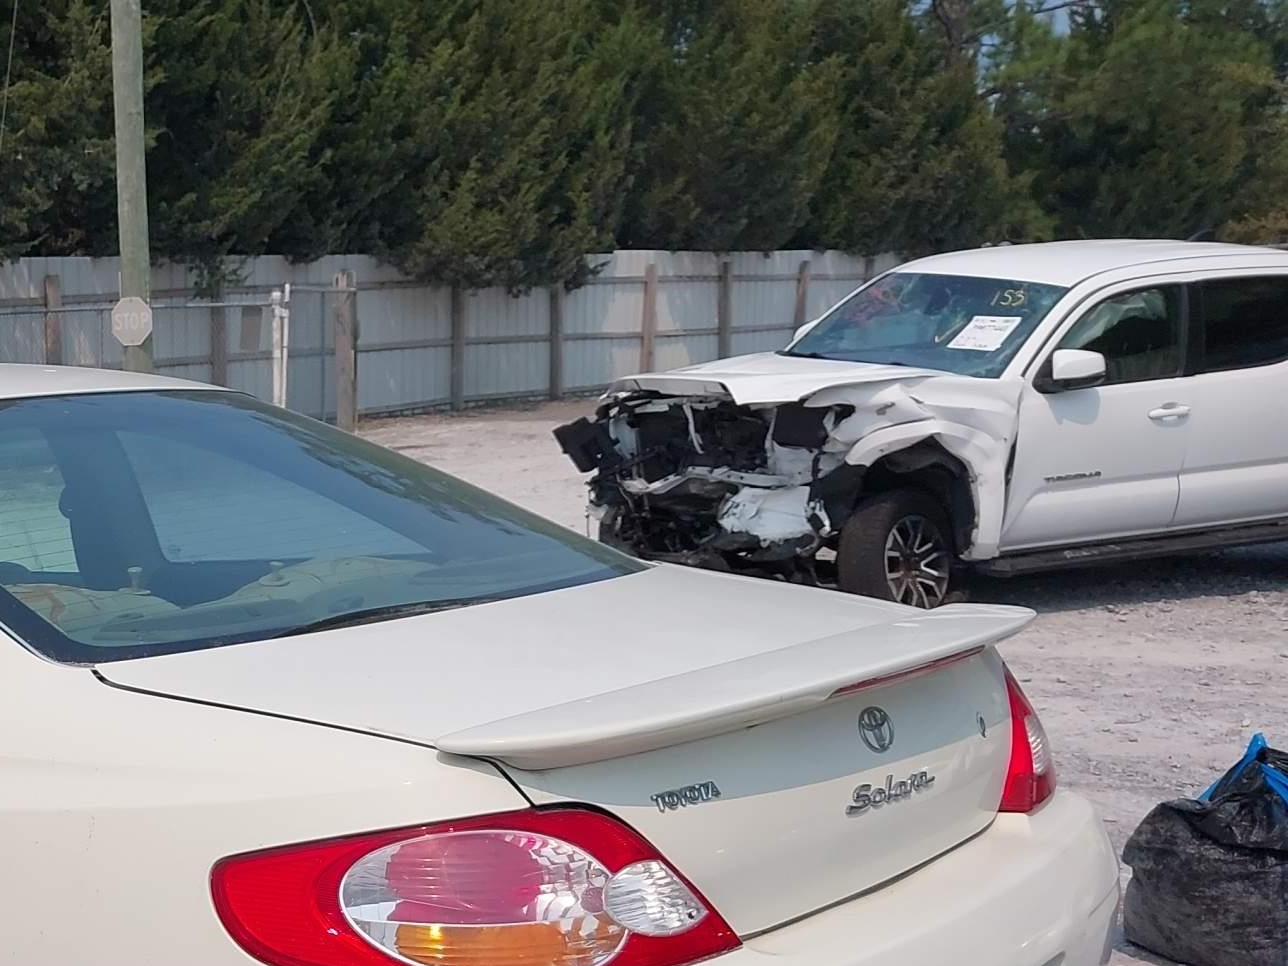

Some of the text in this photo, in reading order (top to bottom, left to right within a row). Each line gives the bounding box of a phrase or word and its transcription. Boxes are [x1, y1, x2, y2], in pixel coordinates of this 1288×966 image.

[114, 312, 150, 330] STOP
[650, 780, 721, 813] TOYOTA
[845, 771, 935, 816] Solara
